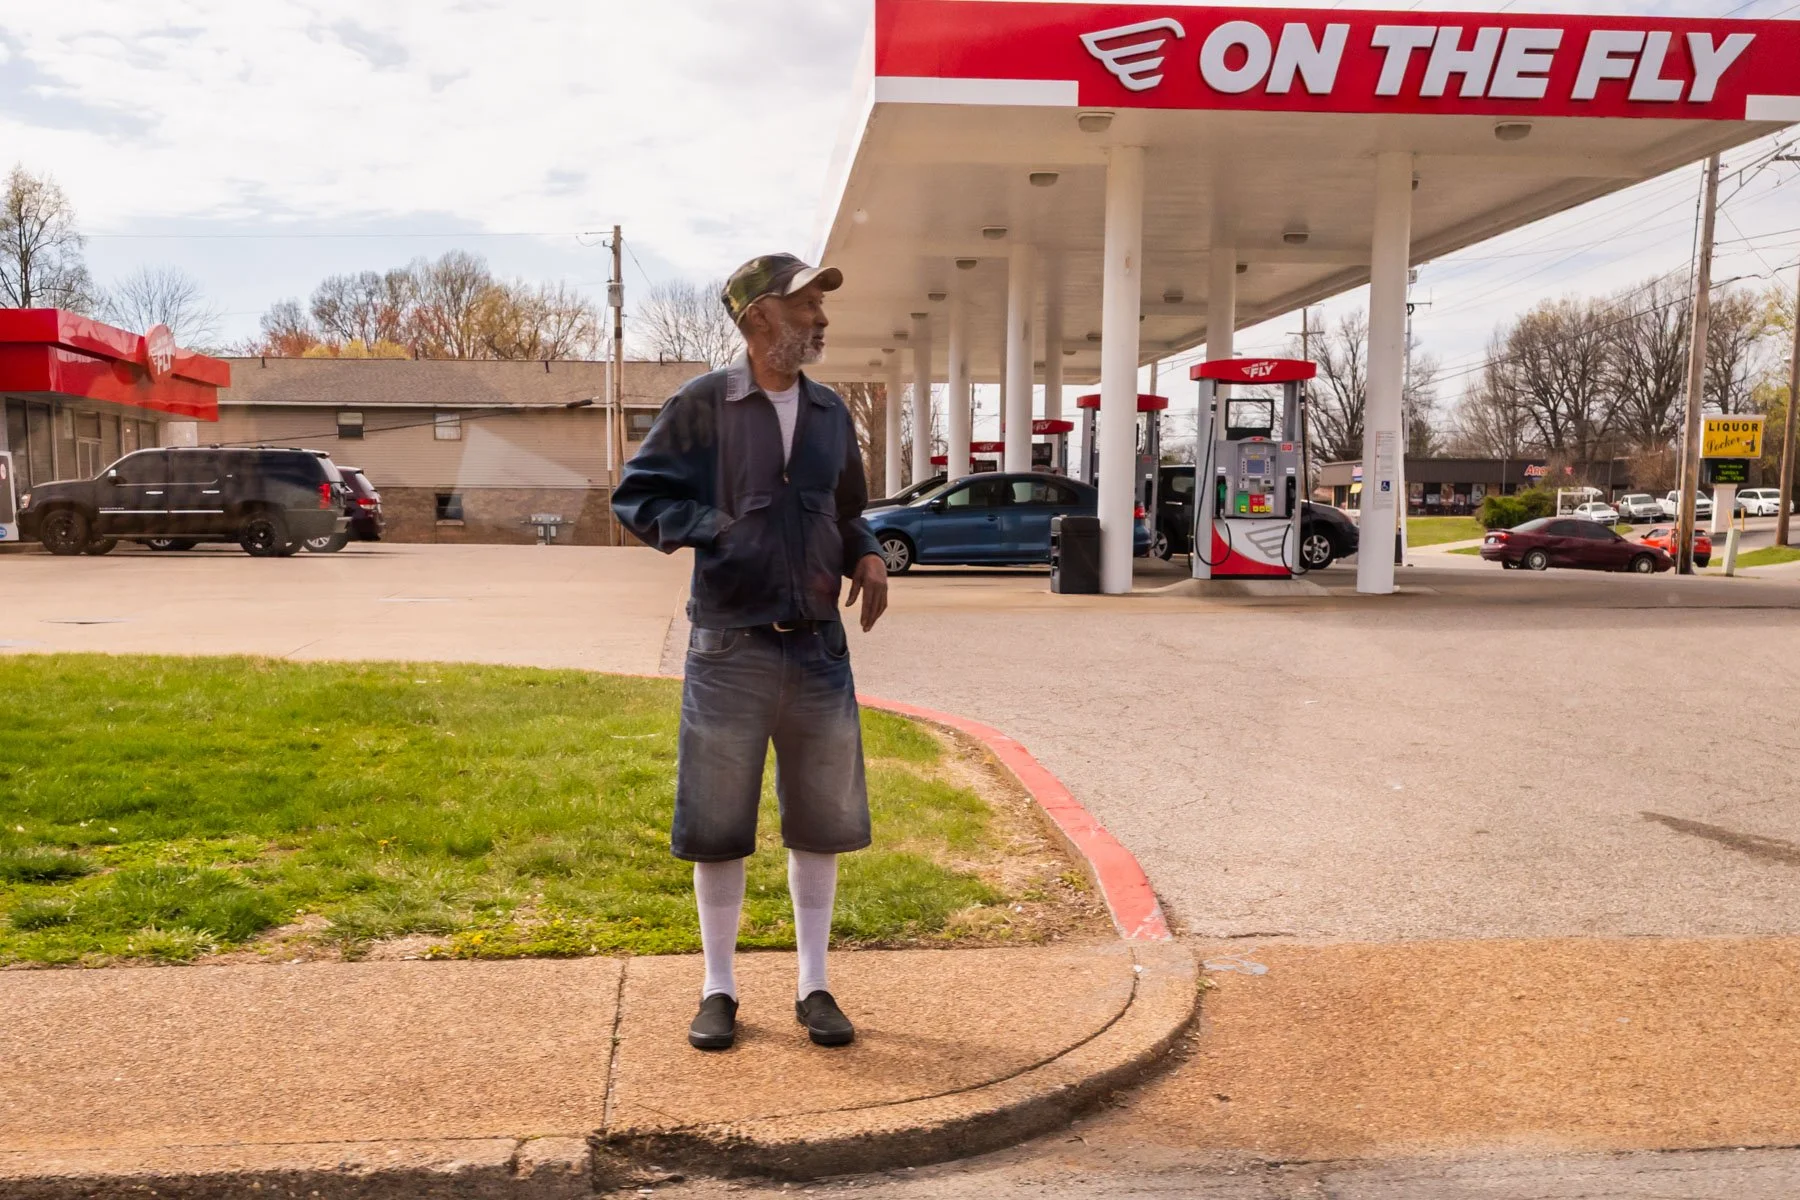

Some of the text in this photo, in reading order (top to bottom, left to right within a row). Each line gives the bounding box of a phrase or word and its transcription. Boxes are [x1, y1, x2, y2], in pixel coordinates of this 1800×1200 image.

[1199, 20, 1757, 103] ON THE FLY
[1250, 365, 1273, 378] FLY
[1708, 422, 1758, 432] LIQUOR
[1706, 433, 1740, 452] Locker
